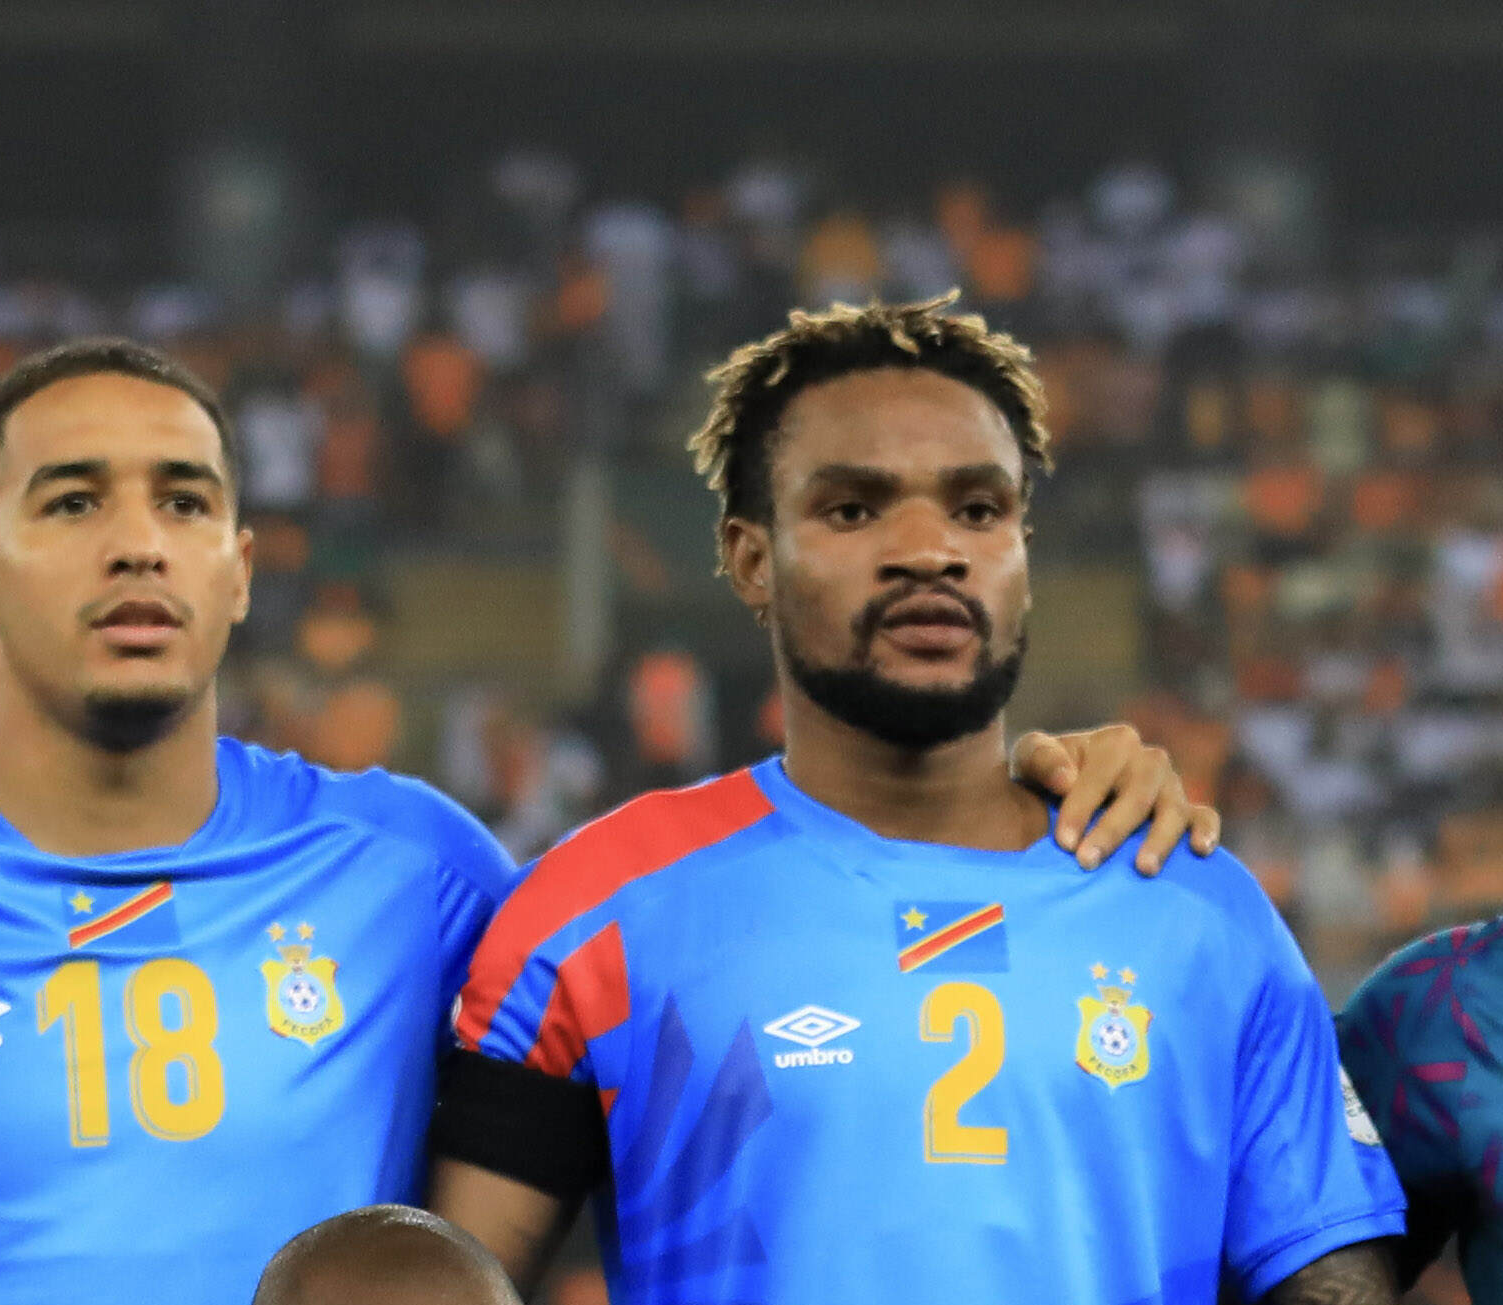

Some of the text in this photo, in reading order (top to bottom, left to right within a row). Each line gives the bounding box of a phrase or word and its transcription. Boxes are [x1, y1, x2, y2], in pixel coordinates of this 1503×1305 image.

[37, 957, 226, 1148] 18
[774, 1047, 855, 1070] umbro
[919, 982, 1008, 1164] 2
